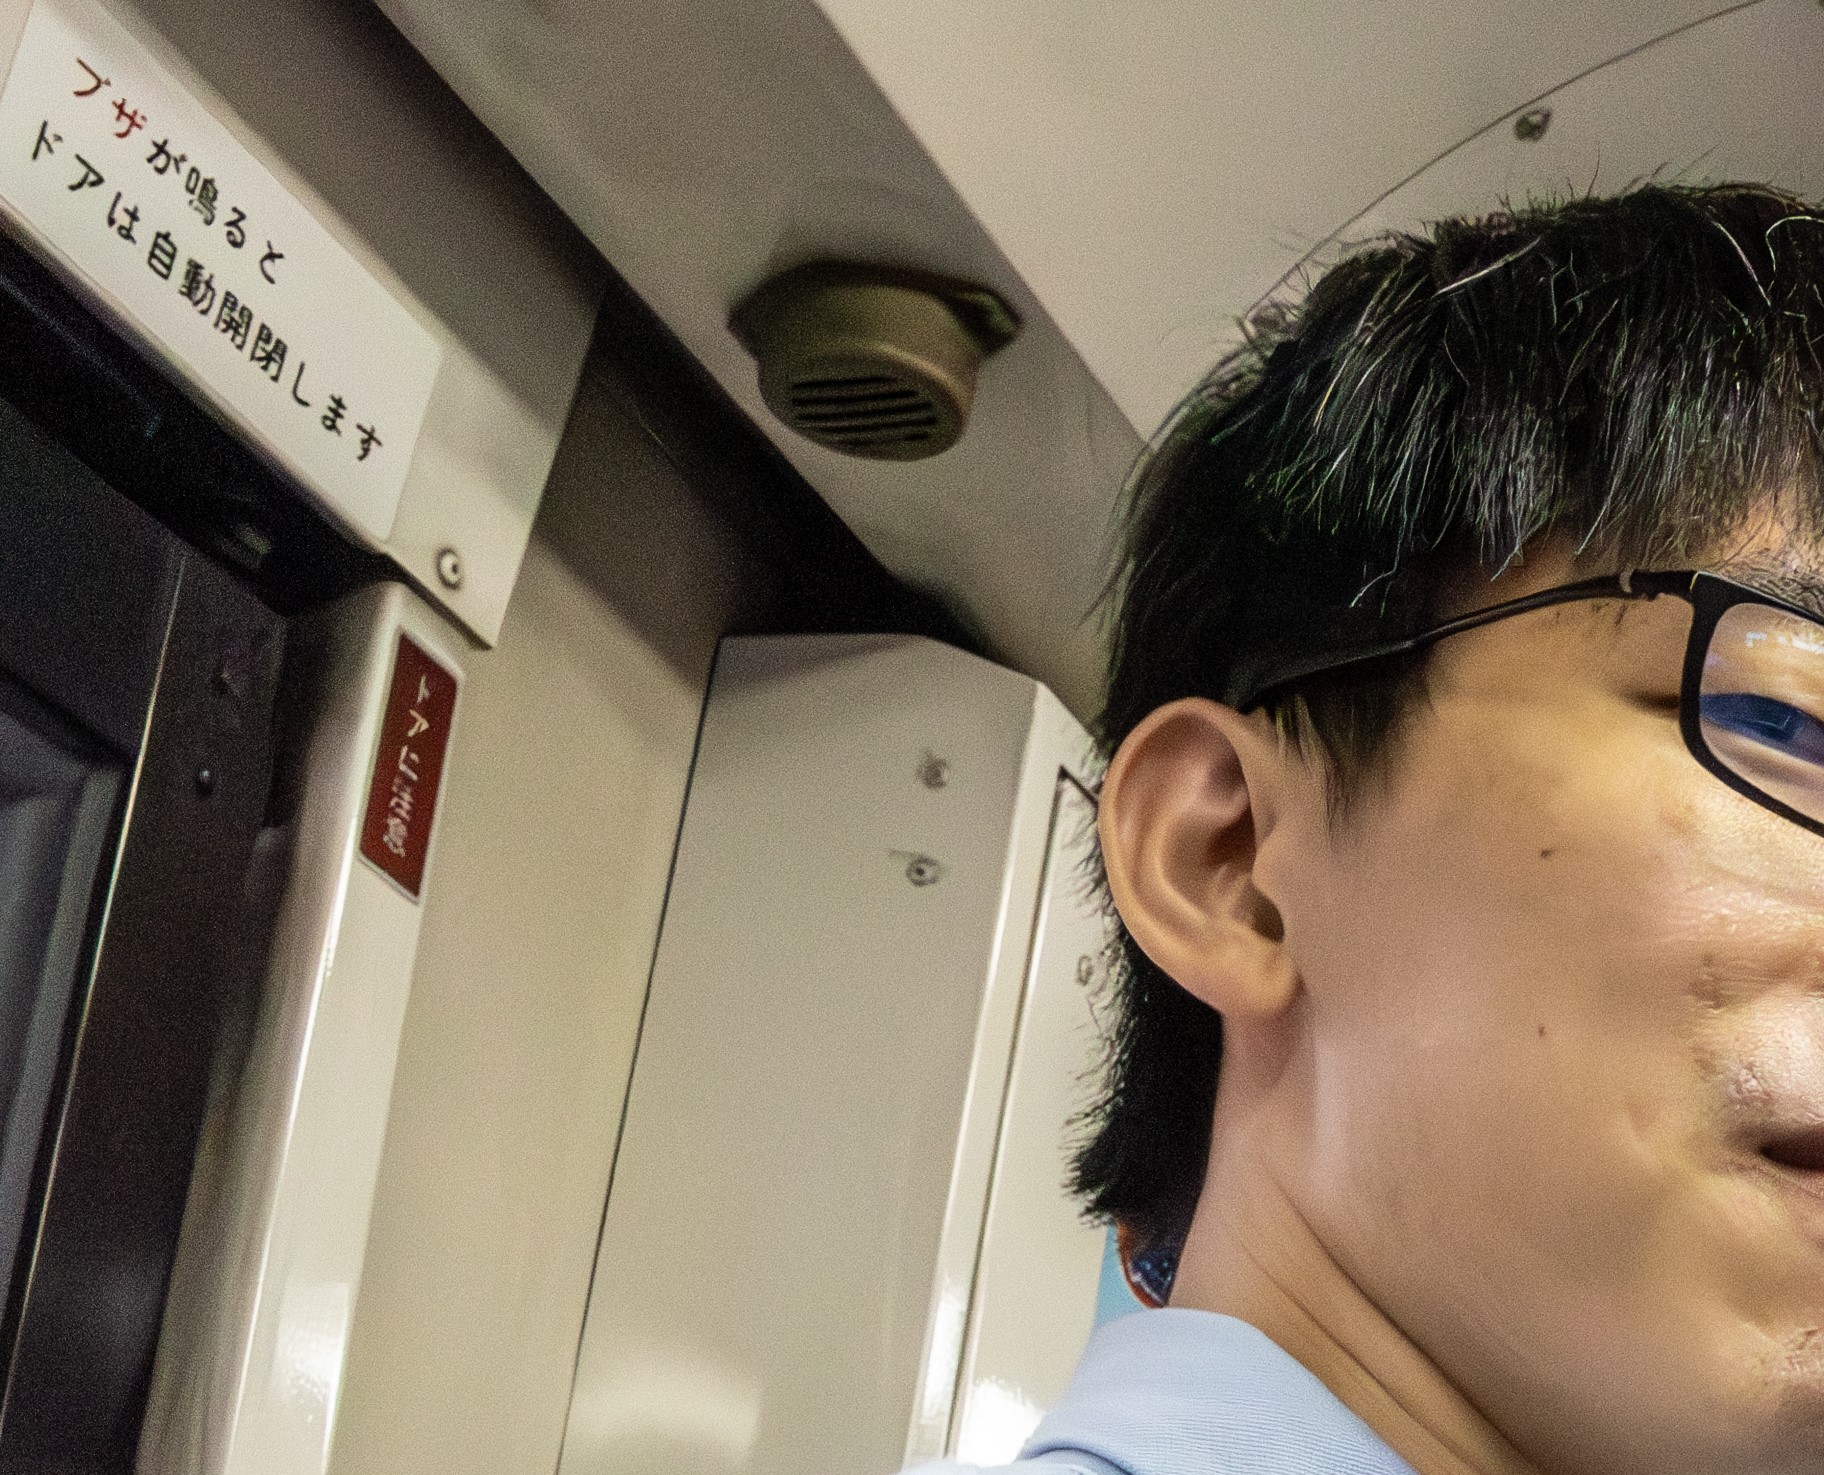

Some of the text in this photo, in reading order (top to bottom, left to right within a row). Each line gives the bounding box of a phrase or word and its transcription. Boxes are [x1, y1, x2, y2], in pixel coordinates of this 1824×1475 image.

[31, 120, 383, 462] ドアは自動開閉します
[73, 57, 285, 285] ブザが鳴ると
